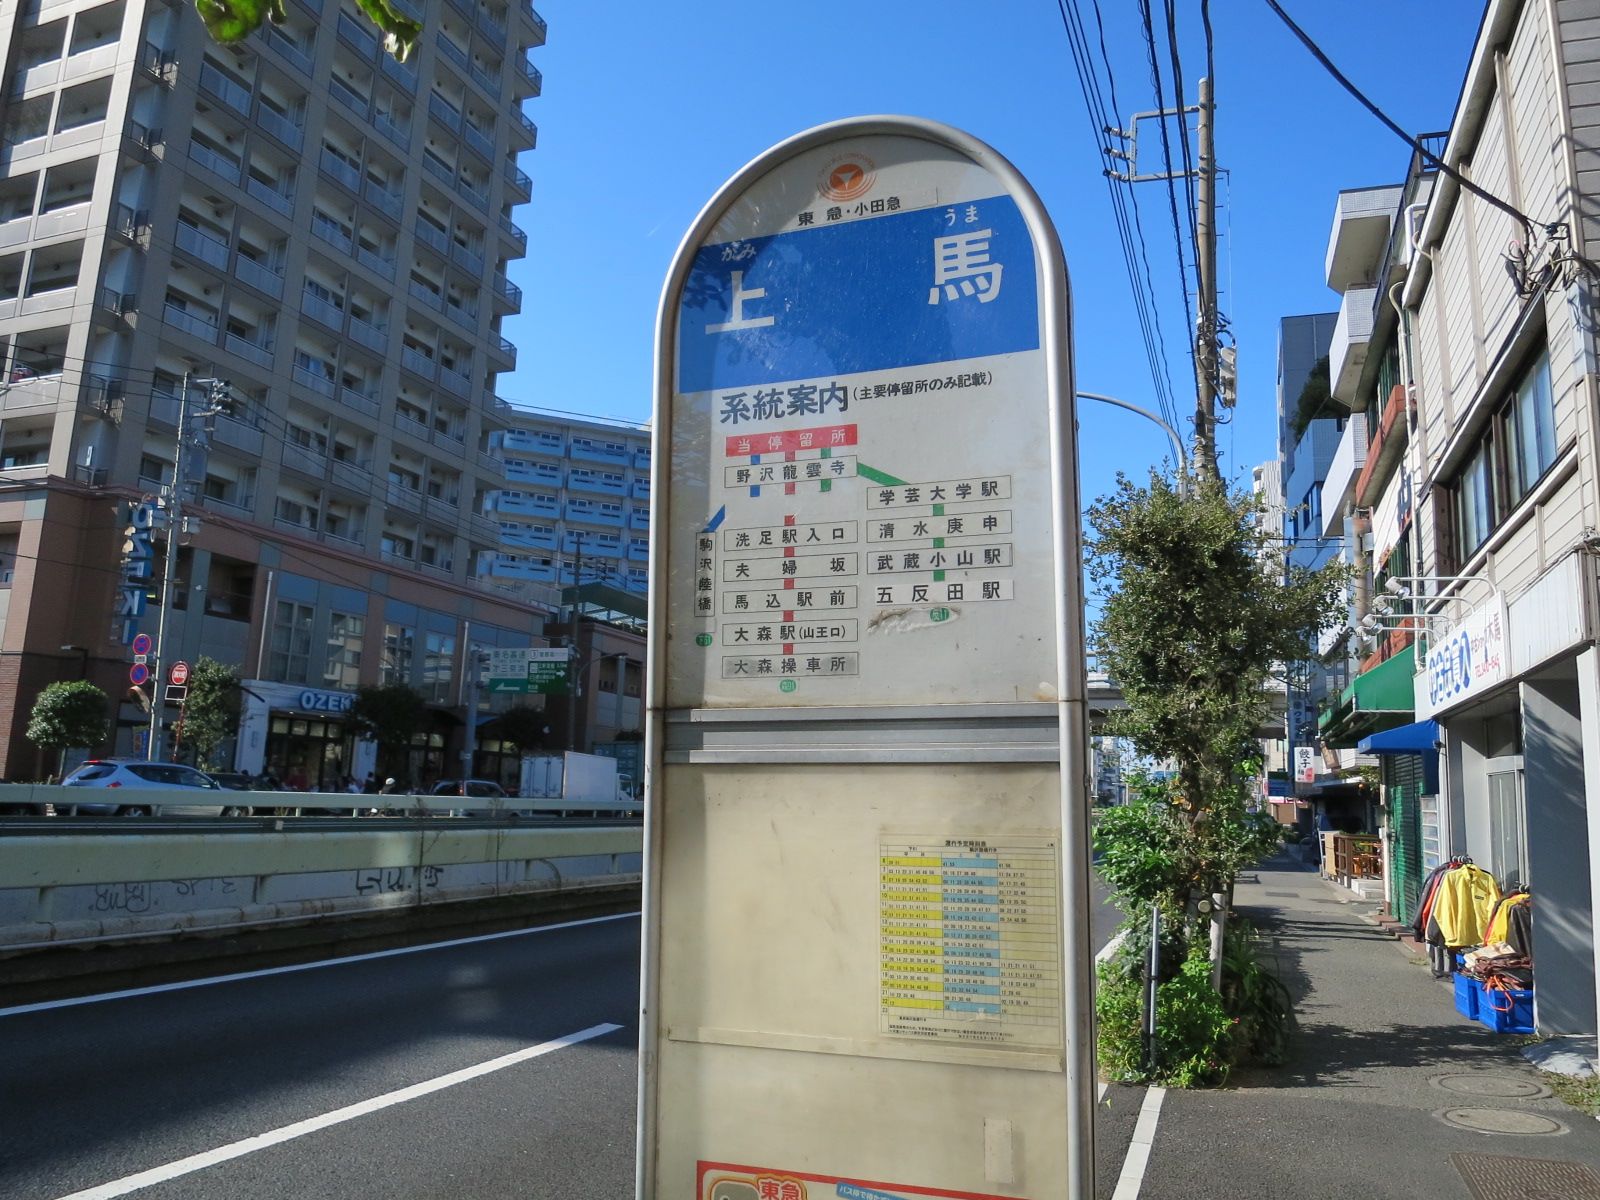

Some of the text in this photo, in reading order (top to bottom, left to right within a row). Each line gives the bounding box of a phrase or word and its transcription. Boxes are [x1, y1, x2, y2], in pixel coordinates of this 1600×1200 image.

[797, 196, 901, 226] 東急・小田急
[944, 205, 979, 227] うま
[705, 228, 1003, 336] 上 馬
[719, 371, 994, 424] 系統案内 (主要停留所のみ記載)
[737, 429, 846, 452] 当停留所
[736, 460, 845, 483] 野沢龍雲寺
[879, 480, 998, 505] 学芸大学駅
[735, 527, 845, 547] 洗足駅入口
[879, 516, 999, 539] 清水庚申
[735, 556, 845, 578] 夫婦坂
[877, 549, 1001, 570] 武蔵小山駅
[698, 535, 713, 611] 駒沢陸橋
[735, 590, 845, 609] 馬込駅前
[877, 580, 1001, 603] 五反田駅
[735, 624, 846, 642] 大森駅(山王口)
[734, 656, 846, 674] 大森操車所
[1299, 749, 1311, 768] 餃子
[760, 1181, 801, 1200] 東急
